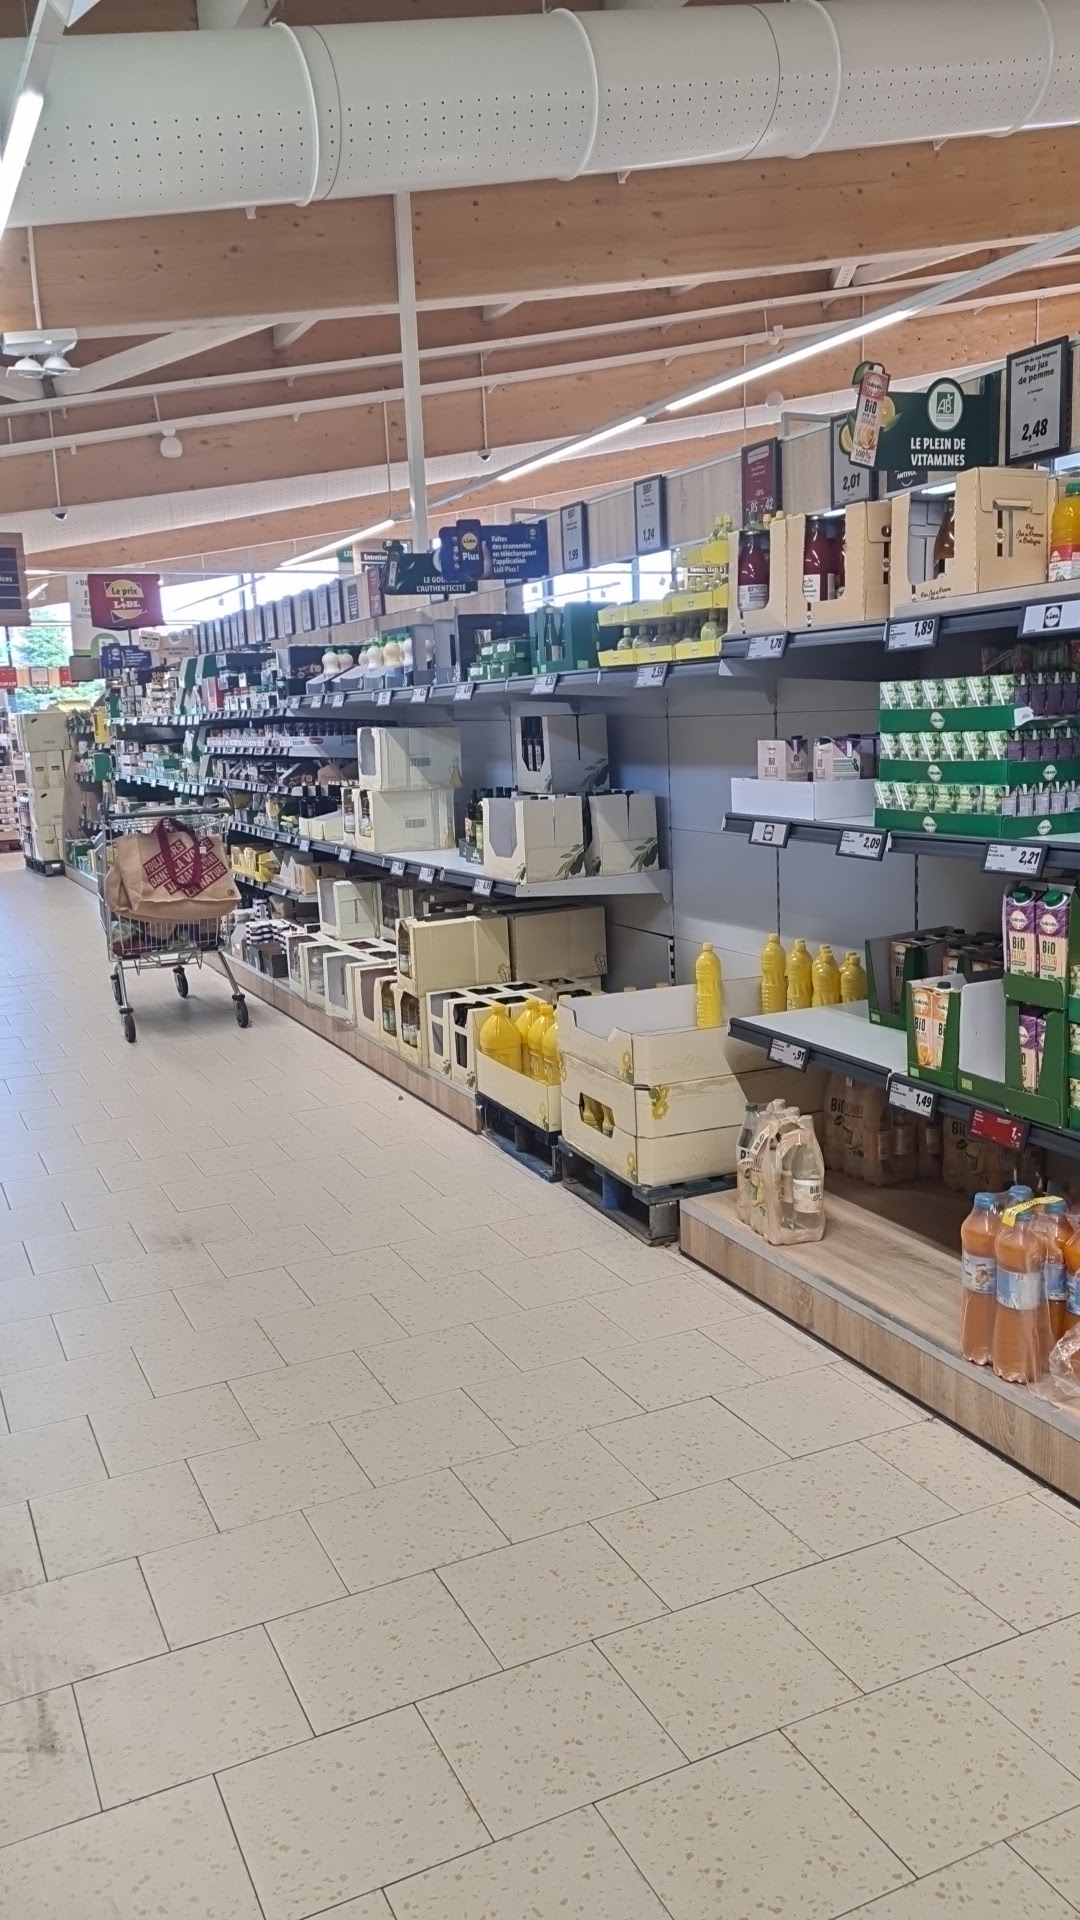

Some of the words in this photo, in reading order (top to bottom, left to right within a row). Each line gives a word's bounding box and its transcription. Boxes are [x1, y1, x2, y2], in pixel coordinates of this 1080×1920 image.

[1024, 364, 1036, 374] Pur
[1037, 360, 1049, 371] jus
[1018, 375, 1027, 385] de
[1028, 368, 1054, 385] pomme
[937, 398, 952, 414] AB
[1021, 418, 1048, 443] 2,48
[910, 437, 921, 450] LE
[923, 437, 951, 450] PLEIN
[954, 437, 966, 450] DE
[910, 453, 966, 466] VITAMINES
[842, 472, 861, 491] 2,01
[642, 527, 655, 543] 1,24
[491, 542, 502, 550] des
[502, 542, 531, 550] économies
[363, 553, 388, 561] Entretien
[462, 552, 480, 561] Plus
[568, 549, 579, 562] 1,99
[111, 587, 121, 595] Le
[122, 587, 138, 597] prix
[416, 583, 467, 592] L'AUTHENTICITÉ
[113, 598, 141, 610] LIDL
[914, 620, 934, 638] 1,89
[769, 637, 783, 651] 1,78
[863, 836, 881, 850] 2,09
[1018, 850, 1040, 866] 2,21
[185, 885, 199, 898] LA
[200, 862, 227, 889] NATURE
[1012, 936, 1025, 951] BiO
[1042, 940, 1056, 955] BiO
[914, 1016, 926, 1031] BiO
[792, 1050, 805, 1062] -,91
[916, 1093, 932, 1107] 1,49
